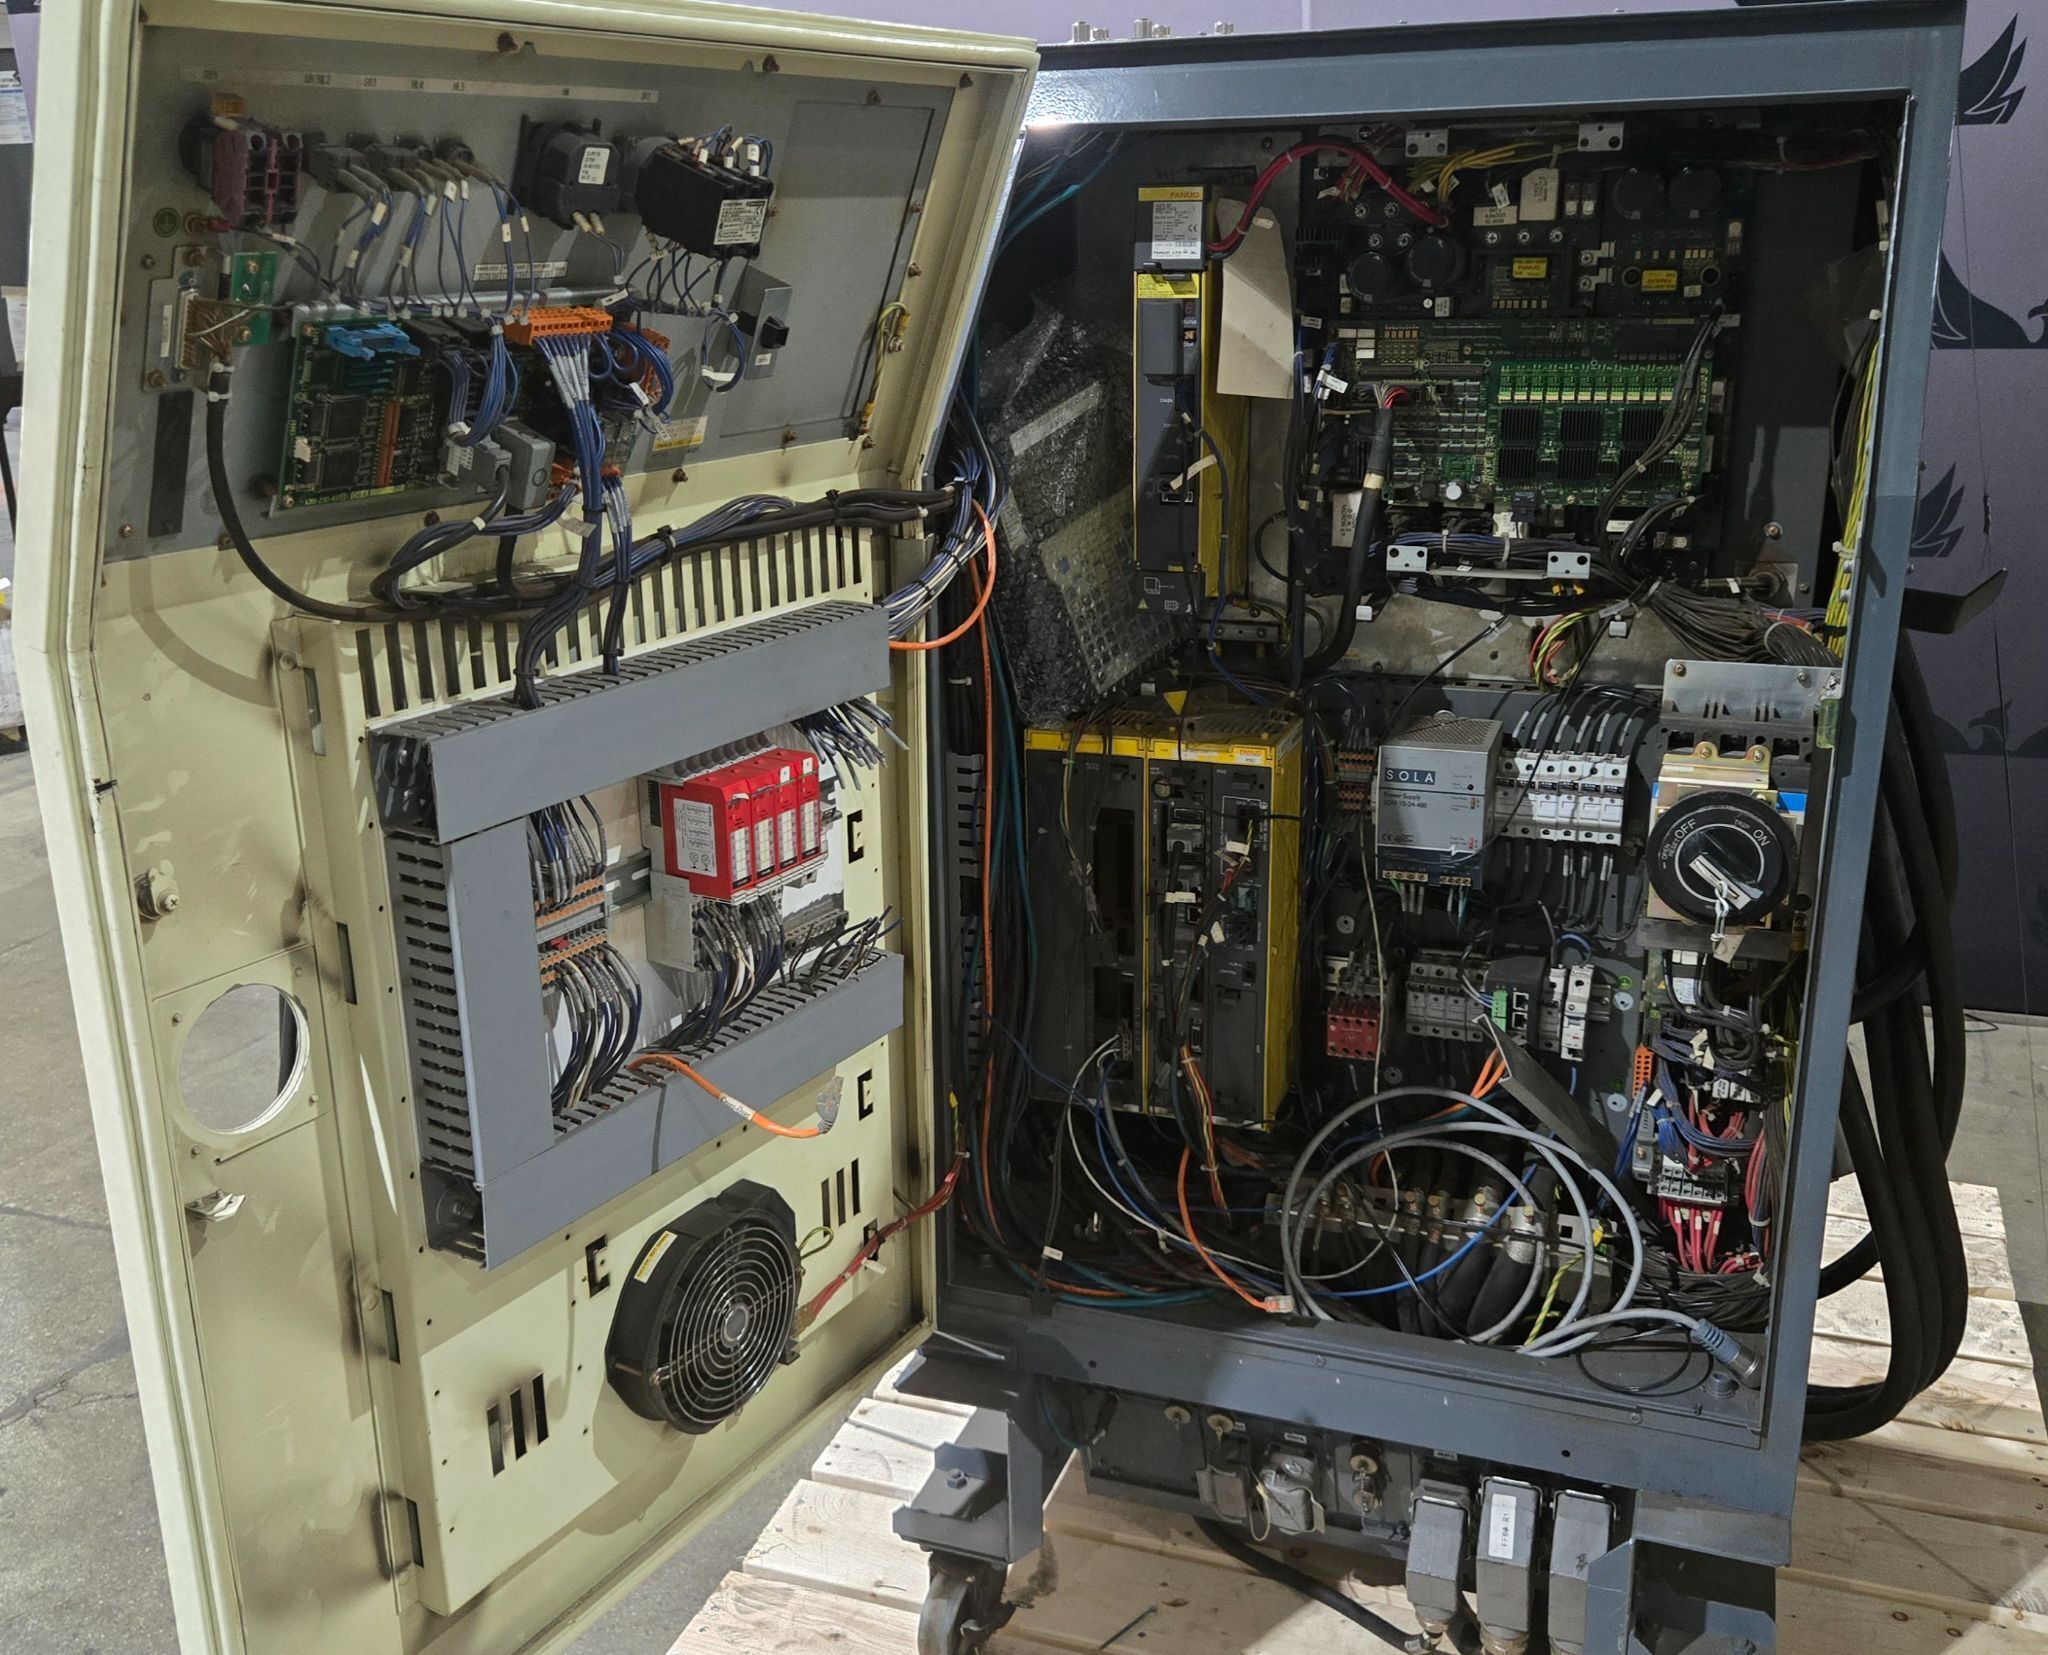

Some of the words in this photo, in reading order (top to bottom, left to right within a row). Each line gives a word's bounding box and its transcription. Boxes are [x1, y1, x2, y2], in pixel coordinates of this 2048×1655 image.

[1386, 770, 1434, 782] SOLA
[1384, 792, 1401, 800] Power
[1403, 793, 1421, 801] Supply
[1674, 819, 1697, 838] OFF
[1734, 818, 1751, 830] TRIP
[1753, 829, 1771, 846] ON
[1661, 844, 1670, 860] OPEN
[1668, 838, 1680, 858] RESET
